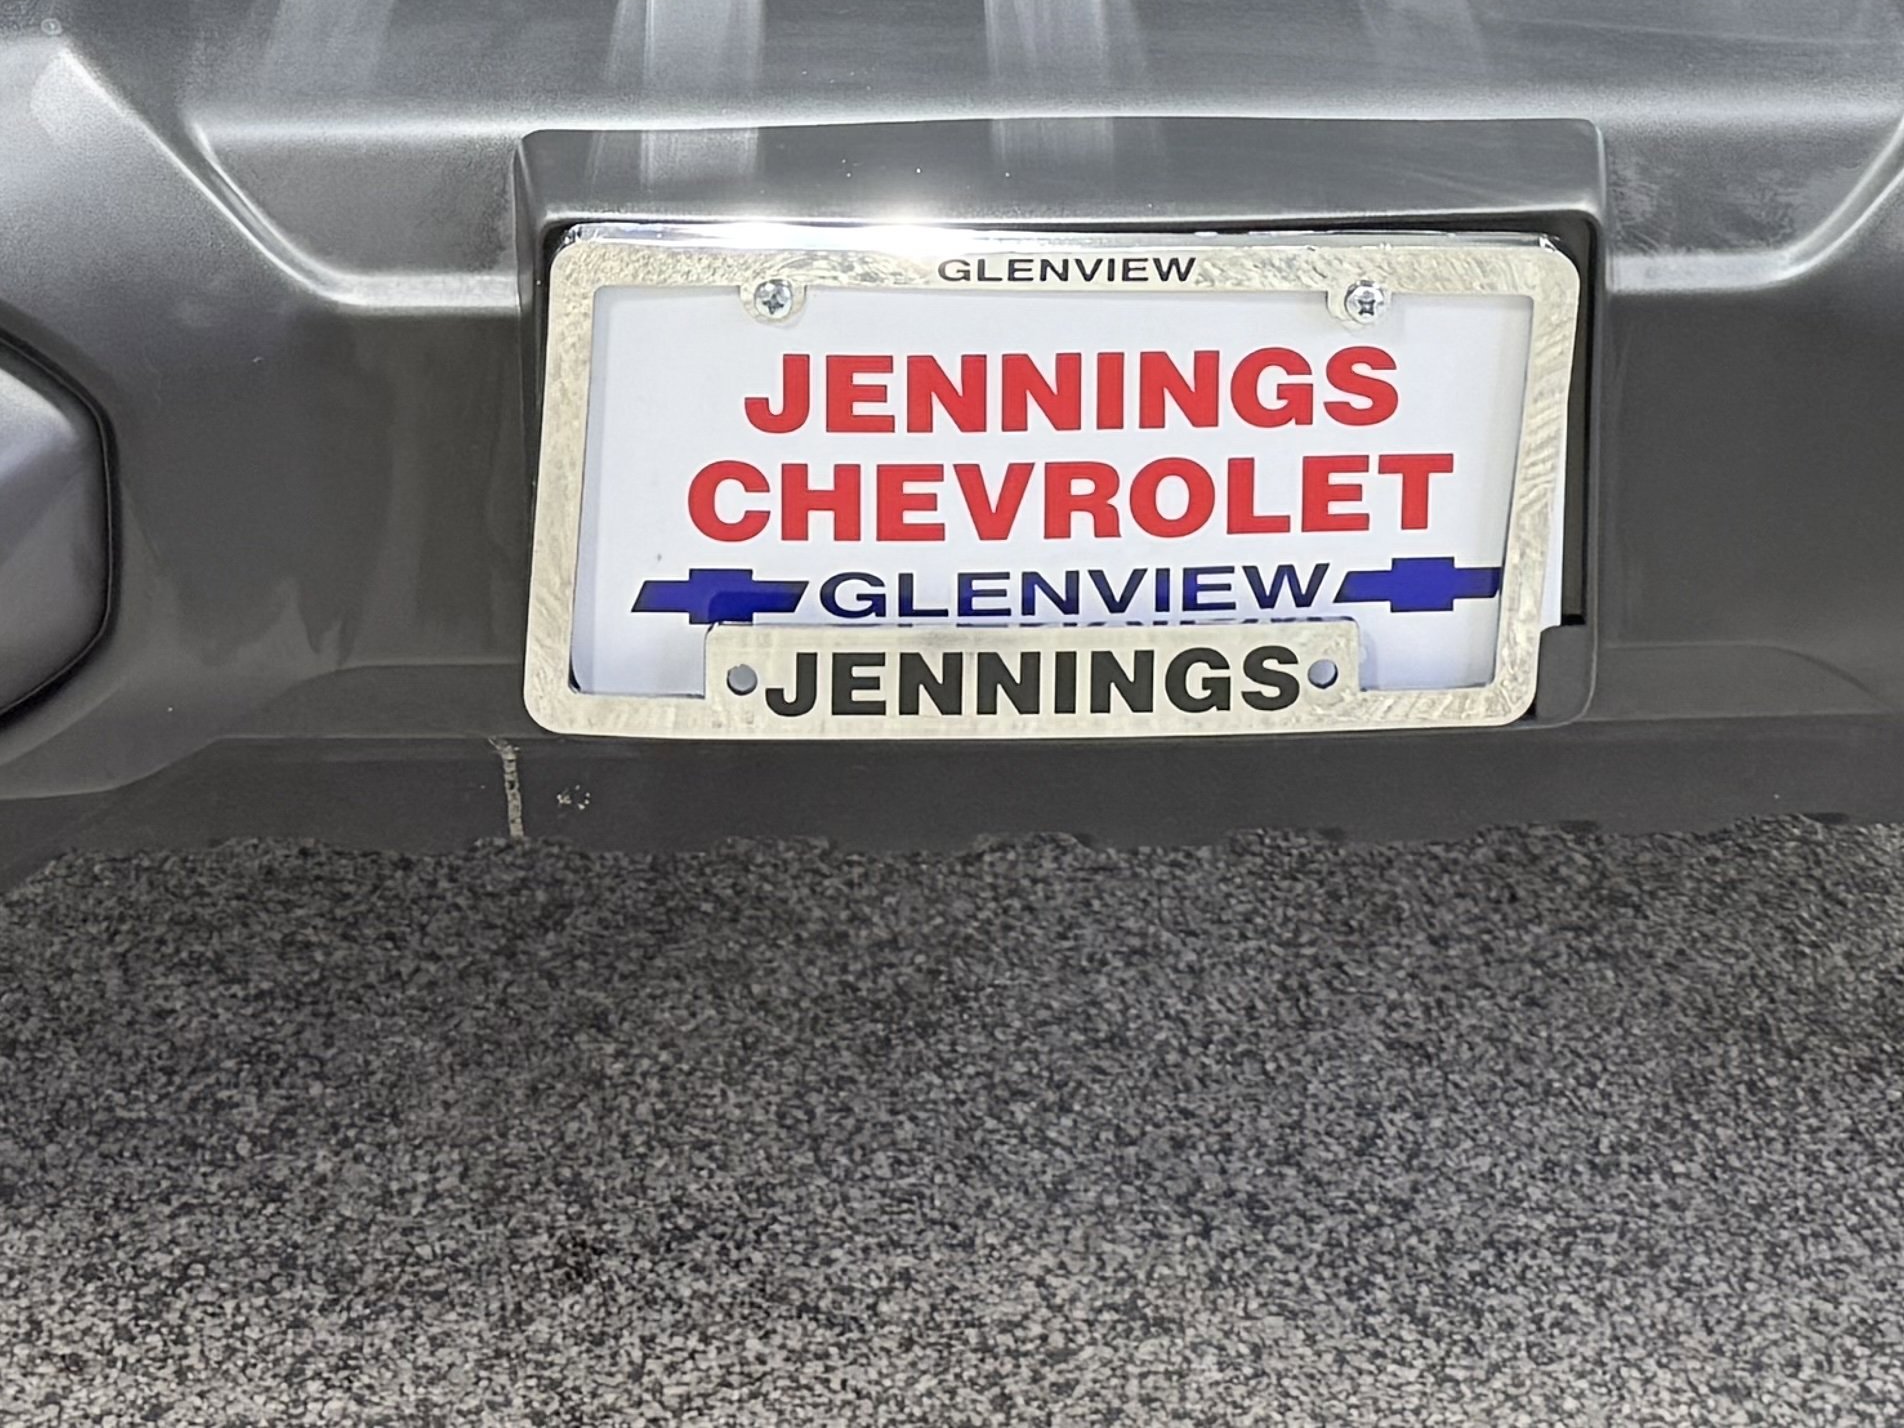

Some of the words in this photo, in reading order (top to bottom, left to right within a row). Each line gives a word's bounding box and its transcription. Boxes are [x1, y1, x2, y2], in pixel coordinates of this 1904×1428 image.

[937, 256, 1198, 282] GLENVIEW
[744, 346, 1399, 434] JENNINGS
[687, 453, 1454, 542] CHEVROLET
[819, 563, 1332, 619] GLENVIEW
[765, 645, 1300, 718] JENNINGS
